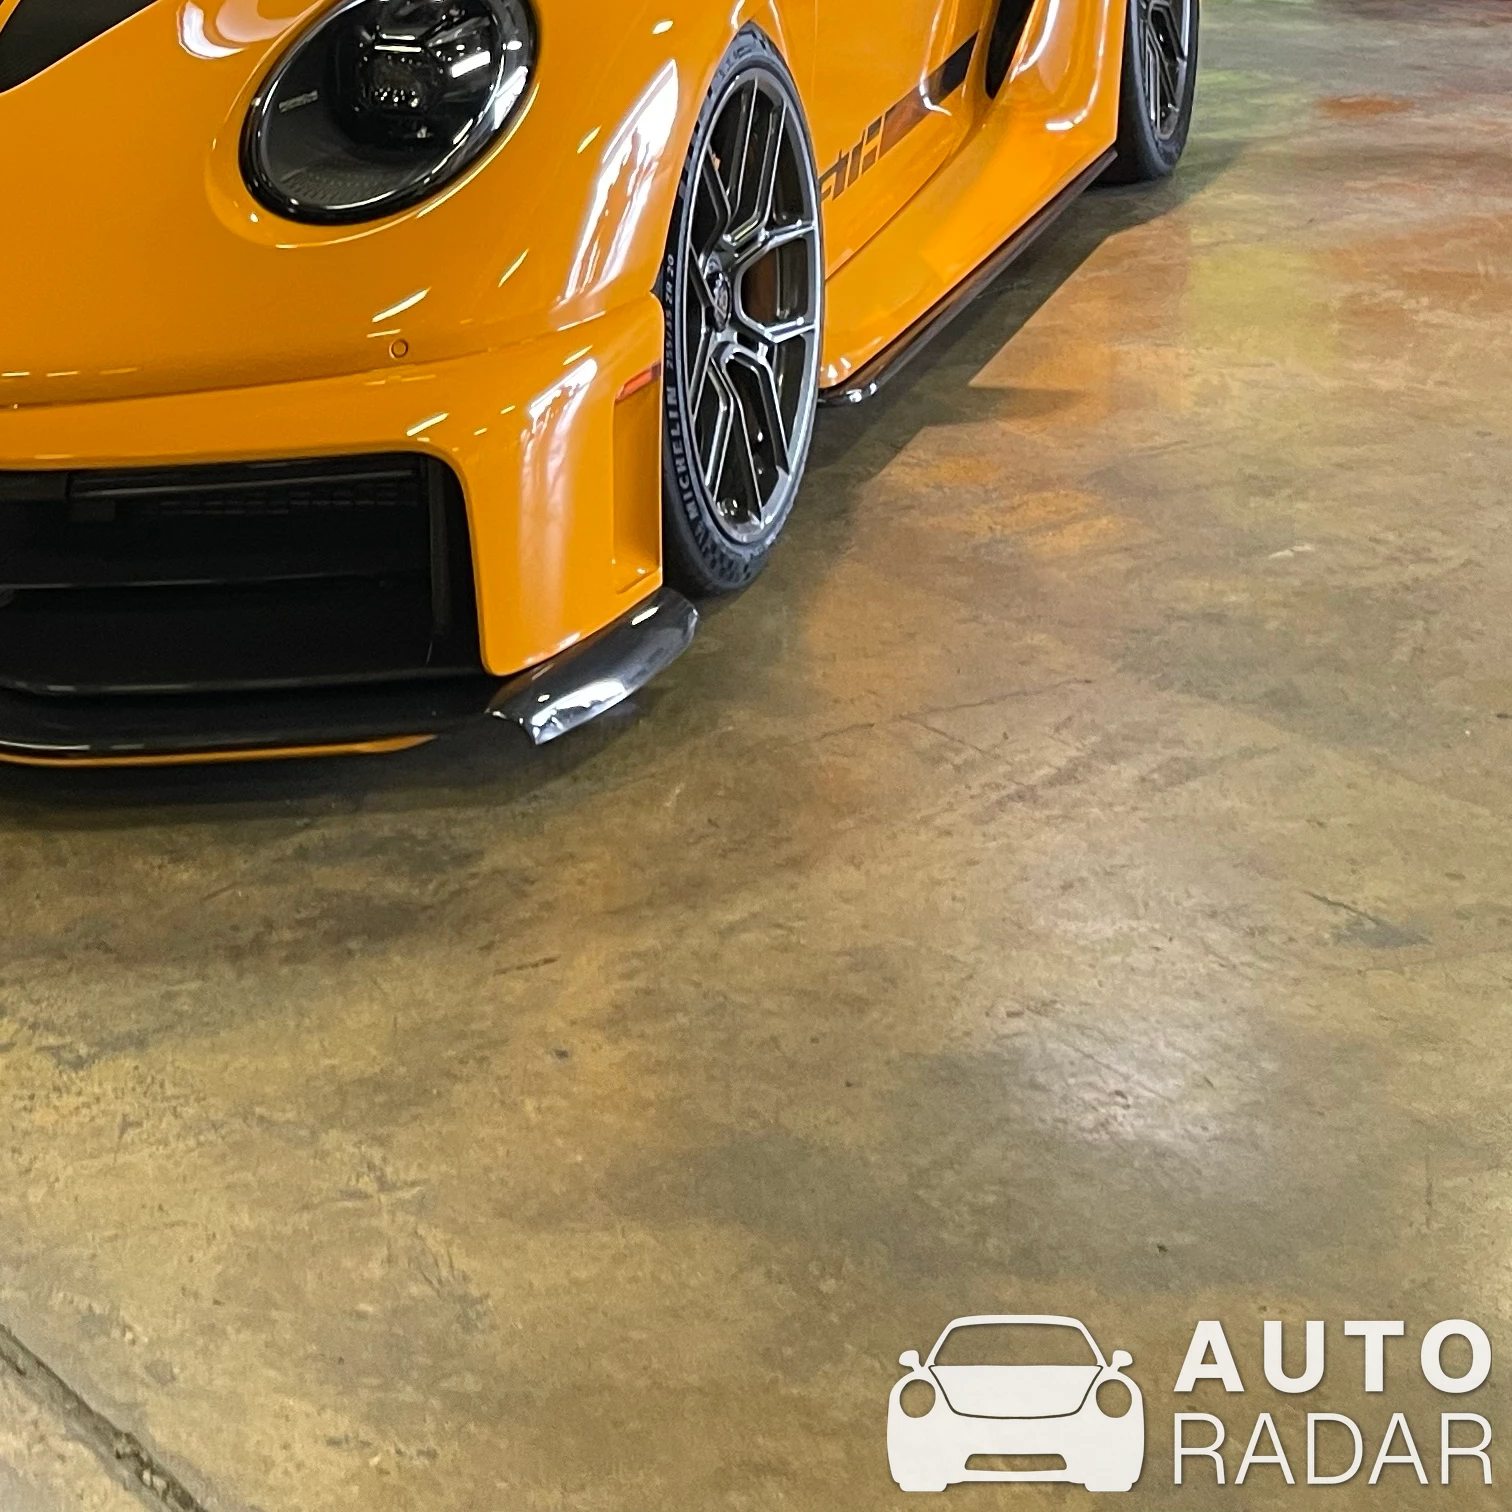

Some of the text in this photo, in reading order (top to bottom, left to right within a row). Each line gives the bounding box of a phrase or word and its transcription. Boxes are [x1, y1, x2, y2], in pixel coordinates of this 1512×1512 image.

[666, 254, 674, 277] 20
[665, 281, 673, 304] ZR
[666, 385, 699, 519] MICHELIN
